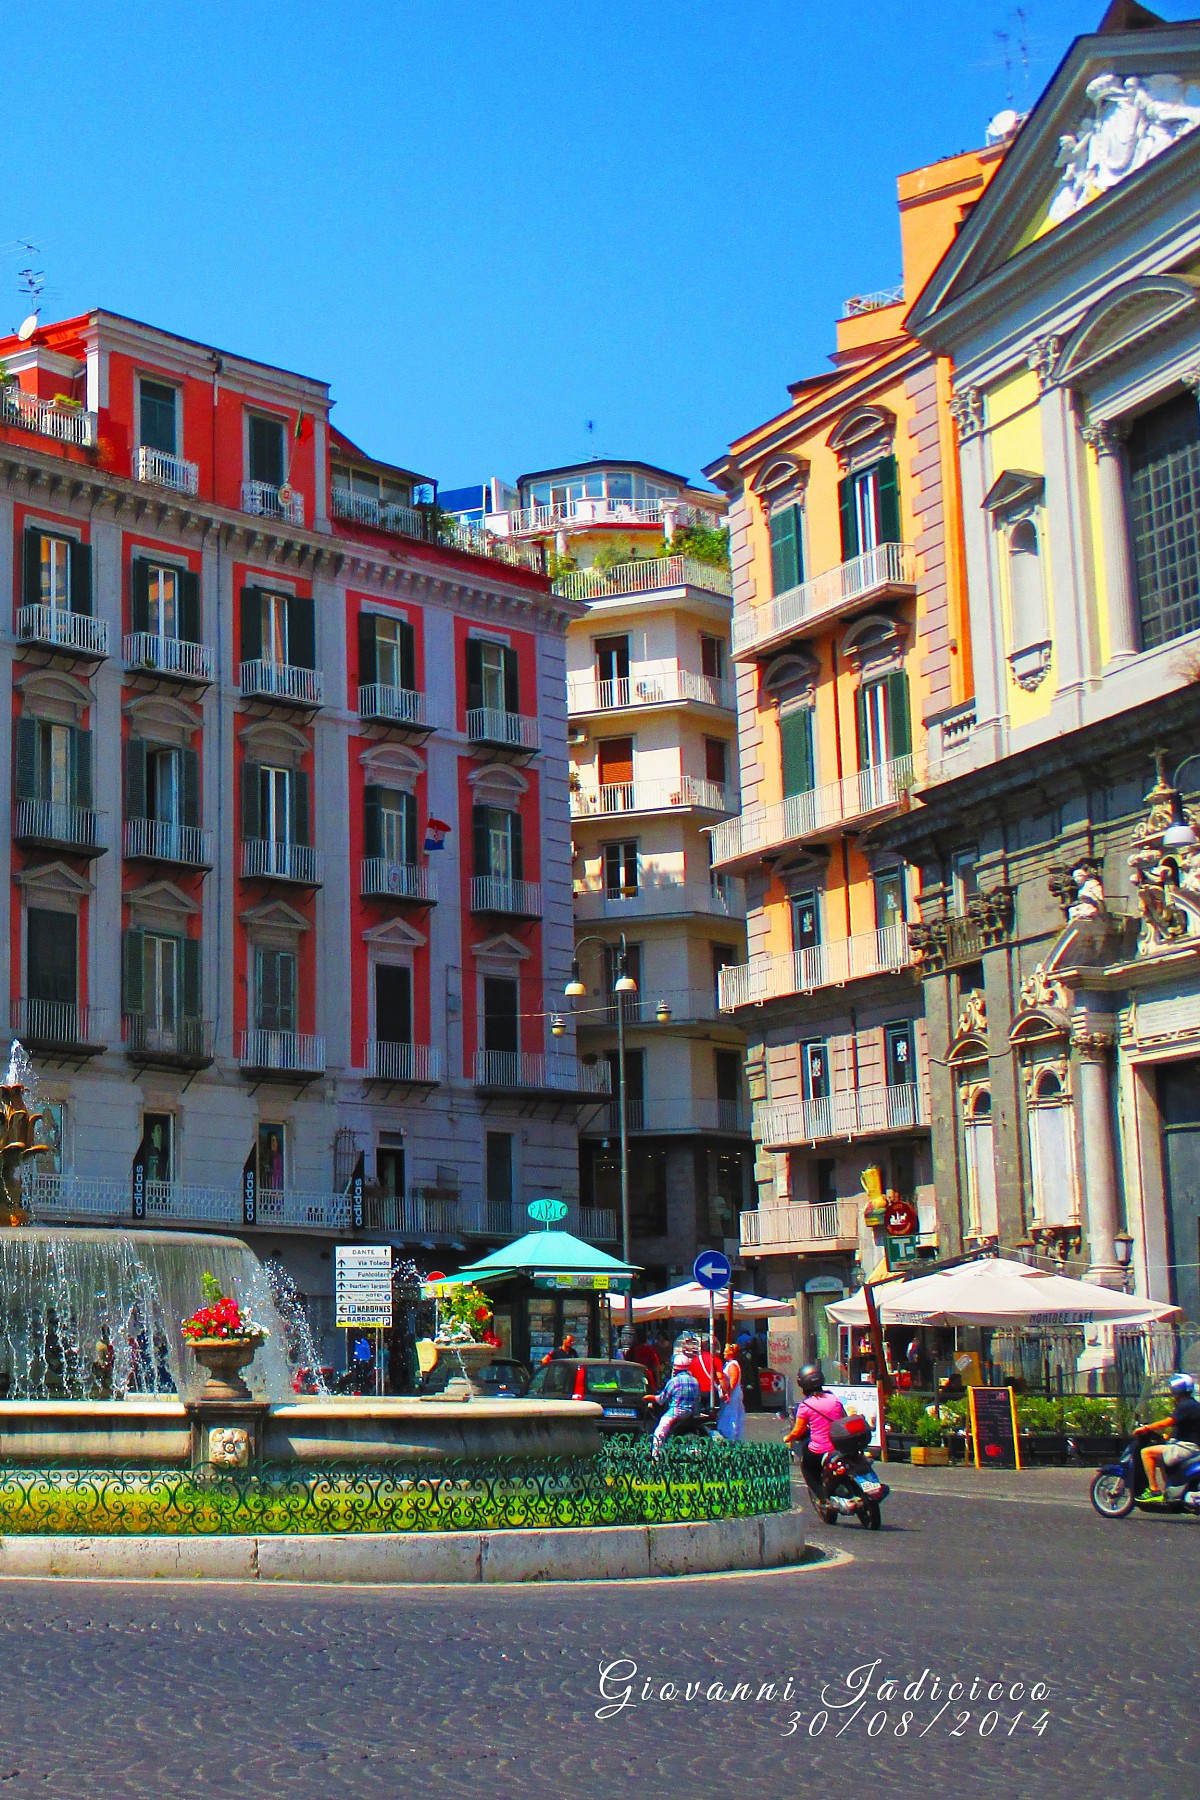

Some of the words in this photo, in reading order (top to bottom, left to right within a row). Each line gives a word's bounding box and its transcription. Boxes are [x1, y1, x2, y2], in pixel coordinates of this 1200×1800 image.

[134, 1165, 144, 1217] adidas
[243, 1171, 254, 1222] adidas
[353, 1178, 363, 1227] adidas
[530, 1199, 568, 1220] PABLO
